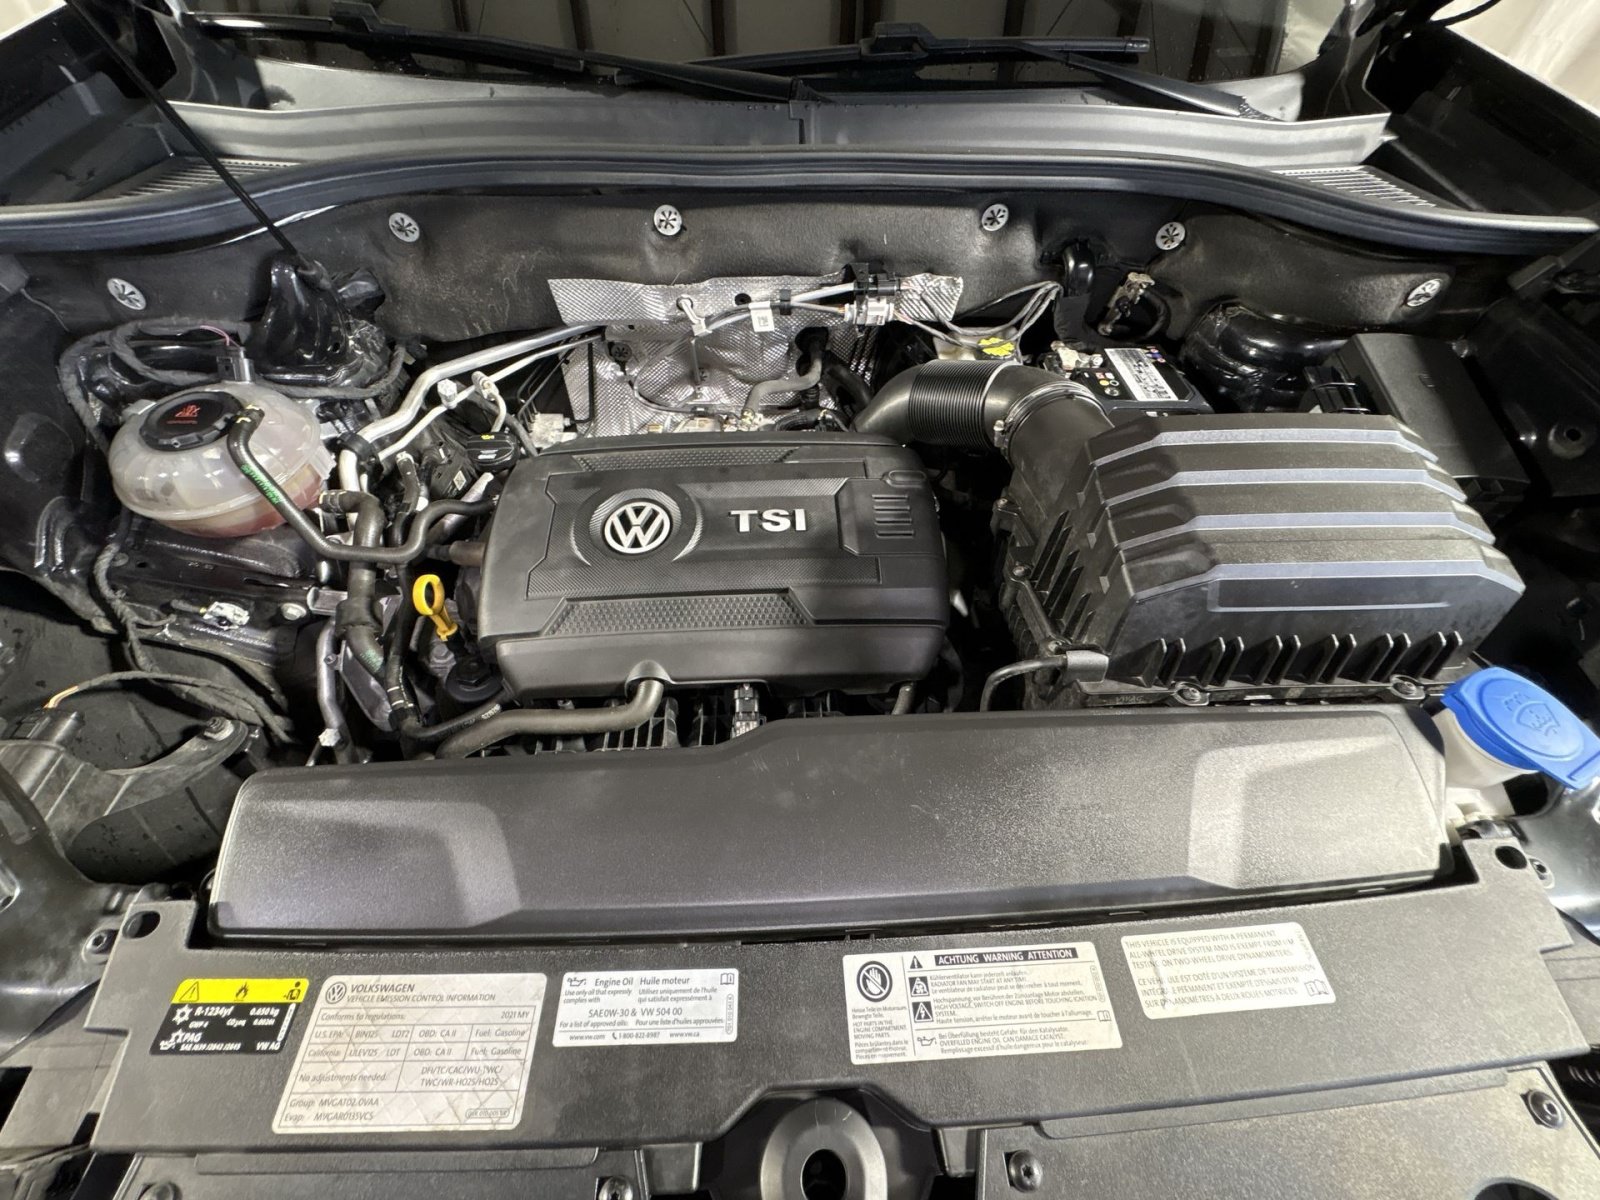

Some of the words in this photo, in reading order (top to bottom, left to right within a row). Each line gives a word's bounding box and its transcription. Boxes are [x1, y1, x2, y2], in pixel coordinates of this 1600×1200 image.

[730, 508, 806, 532] TSI
[1141, 939, 1169, 947] VEHICLE
[1178, 936, 1210, 945] EQUIPPED
[1237, 930, 1275, 939] PERMANENT
[1166, 948, 1187, 956] DRIVE
[1188, 946, 1212, 954] SYSTEM
[1263, 939, 1281, 948] FROM
[938, 955, 979, 965] ACHTUNG
[983, 952, 1023, 962] WARNING
[1028, 950, 1073, 960] ATTENTION
[1174, 956, 1216, 965] TWO-WHEEL
[595, 978, 620, 988] Engine
[622, 977, 633, 985] Oil
[640, 977, 660, 985] Huile
[1180, 975, 1191, 983] EST
[1192, 972, 1210, 981] DOTÉ
[351, 984, 415, 992] VOLKSWAGEN
[1177, 984, 1216, 994] PERMANENT
[1144, 1000, 1158, 1008] SUR
[1241, 990, 1264, 999] ROUES
[194, 1006, 234, 1016] R-1234yf
[631, 1008, 637, 1016] &
[641, 1008, 655, 1016] VW
[656, 1008, 670, 1016] 504
[183, 1033, 202, 1042] PAG
[491, 1047, 521, 1056] Gasoline
[312, 1074, 357, 1084] adjustments
